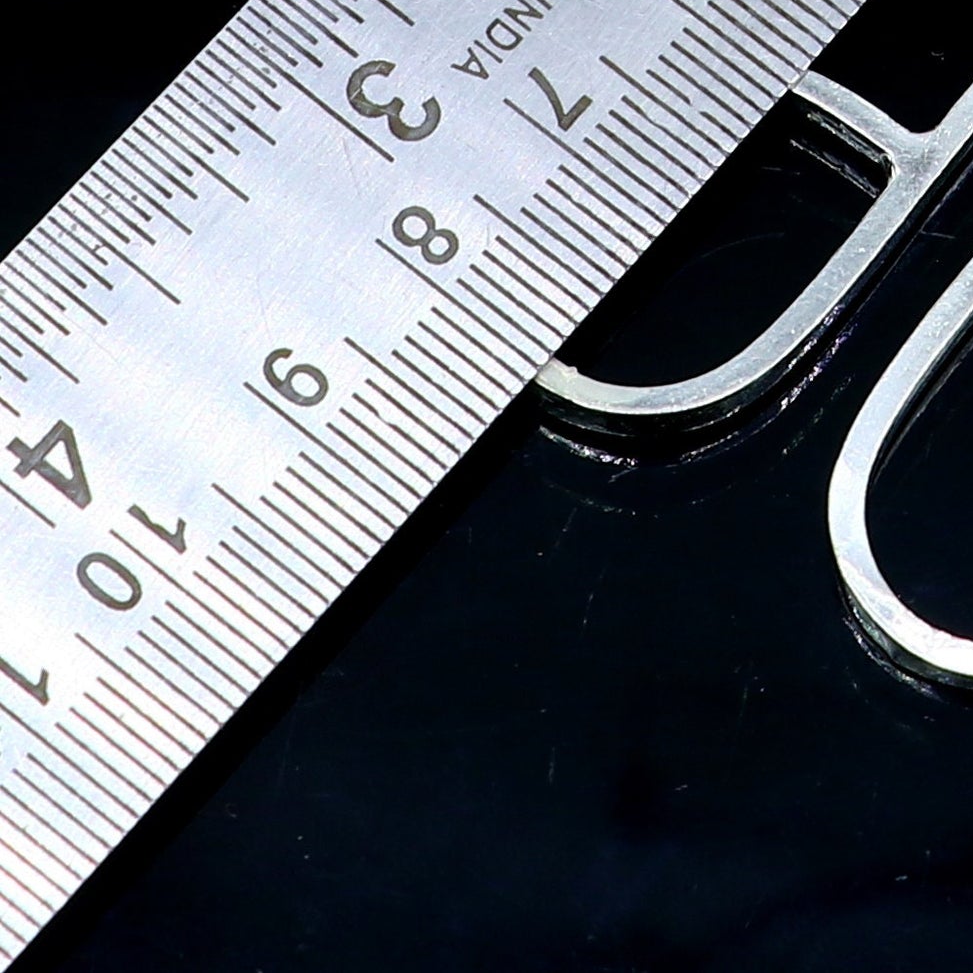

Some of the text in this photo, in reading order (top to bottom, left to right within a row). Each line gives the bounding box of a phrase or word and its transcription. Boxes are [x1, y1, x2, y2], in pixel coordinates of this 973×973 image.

[346, 59, 441, 141] 3
[528, 67, 593, 131] 7
[392, 205, 459, 265] 8
[263, 348, 329, 407] 9
[6, 419, 92, 510] 4
[76, 504, 187, 611] 10
